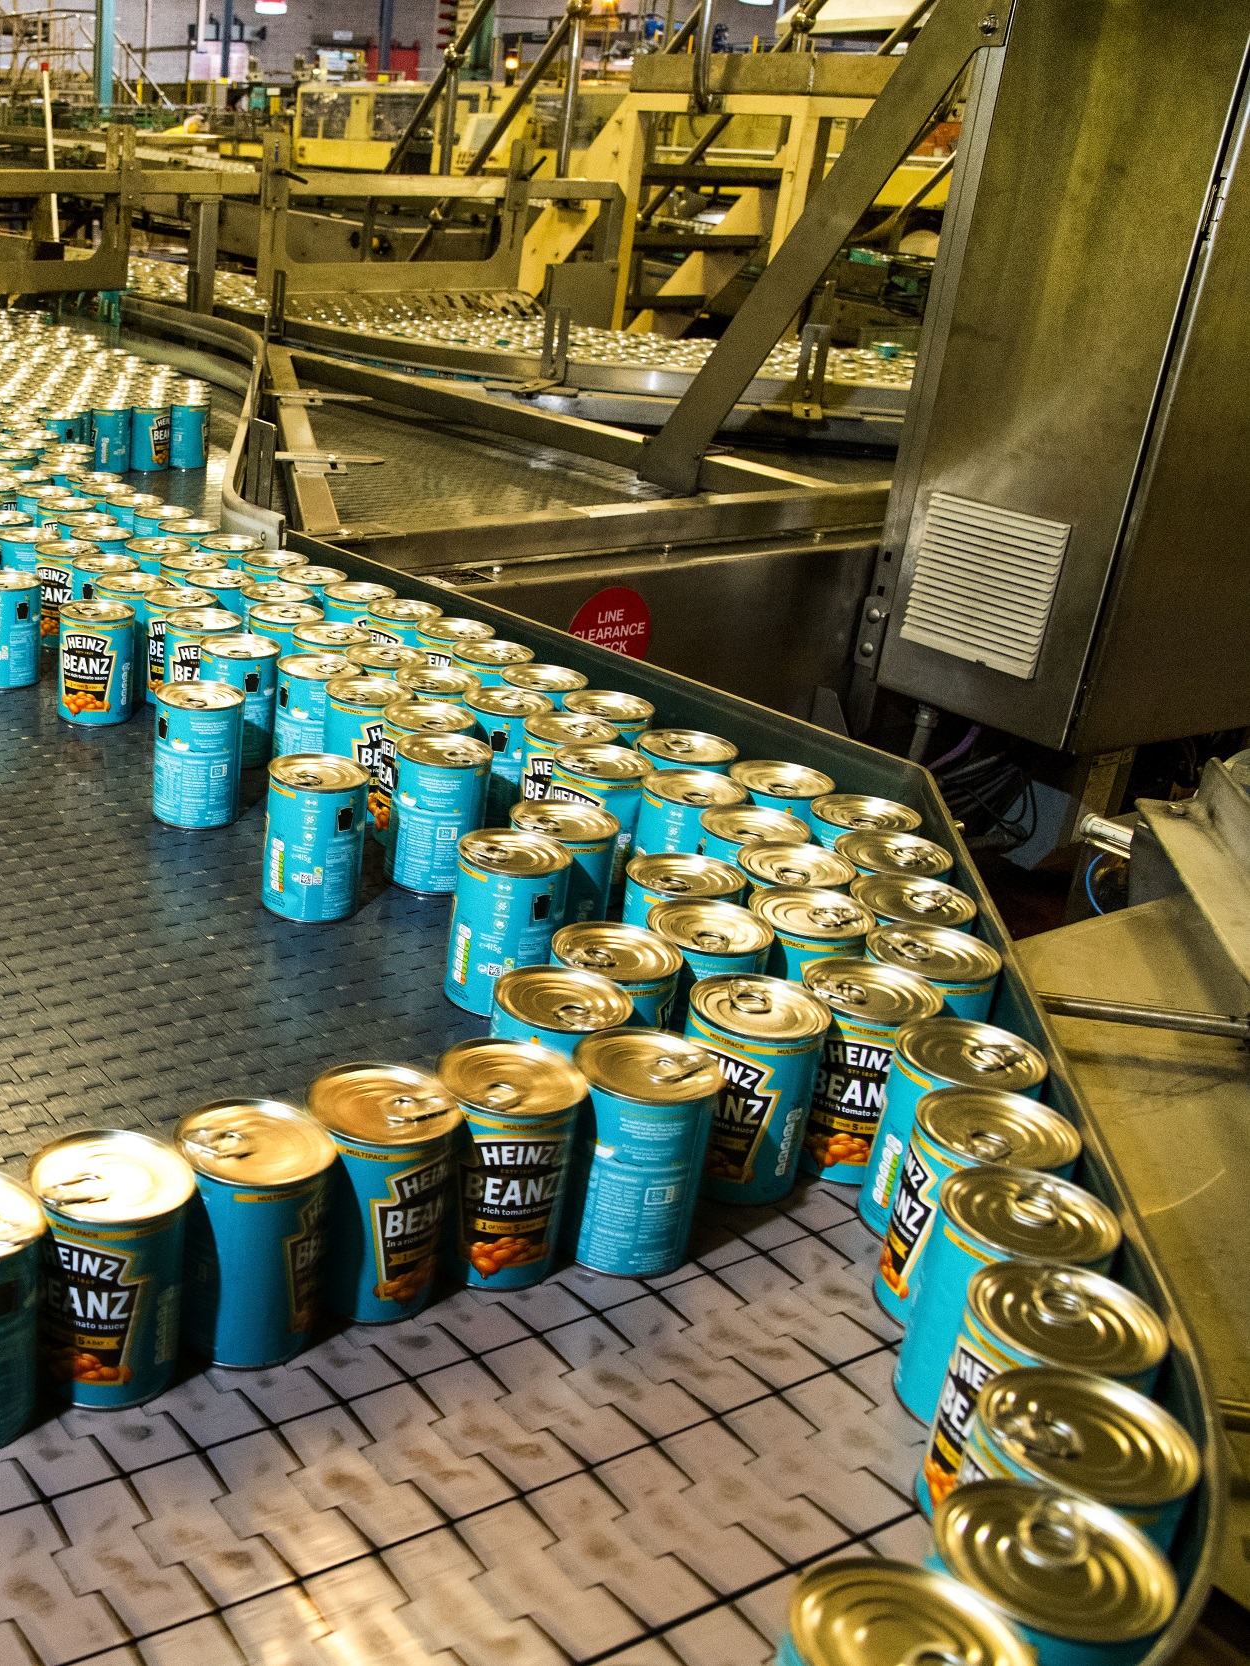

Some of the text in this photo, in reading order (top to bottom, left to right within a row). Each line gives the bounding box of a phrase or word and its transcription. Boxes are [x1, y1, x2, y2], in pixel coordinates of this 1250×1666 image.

[154, 430, 170, 441] BEA
[38, 569, 67, 584] HEINZ
[41, 585, 72, 604] EANZ
[597, 609, 625, 624] LINE
[572, 622, 646, 642] CLEARANCE
[67, 636, 106, 653] HEINZ
[180, 647, 201, 660] HEI
[430, 655, 451, 667] EIN
[63, 653, 111, 675] BEANZ
[174, 664, 200, 682] BEA
[382, 740, 396, 758] HEI
[779, 938, 806, 949] LTIPACK
[848, 1025, 889, 1038] MULTIPACK
[709, 1032, 745, 1050] MULTIPACK
[707, 1053, 759, 1089] INZ
[815, 1069, 886, 1108] BEAN
[841, 1106, 871, 1117] tomato
[503, 1123, 544, 1131] MULTIPACK
[851, 1122, 859, 1131] 5
[346, 1148, 390, 1161] MULTIPACK
[480, 1145, 555, 1166] HEINZ
[401, 1161, 449, 1199] HEIN
[466, 1171, 559, 1207] BEANZ
[482, 1206, 501, 1215] rich
[501, 1207, 532, 1217] tomato
[56, 1222, 99, 1239] MULTIPACK
[57, 1246, 120, 1281] EINZ
[98, 1321, 125, 1331] sauce
